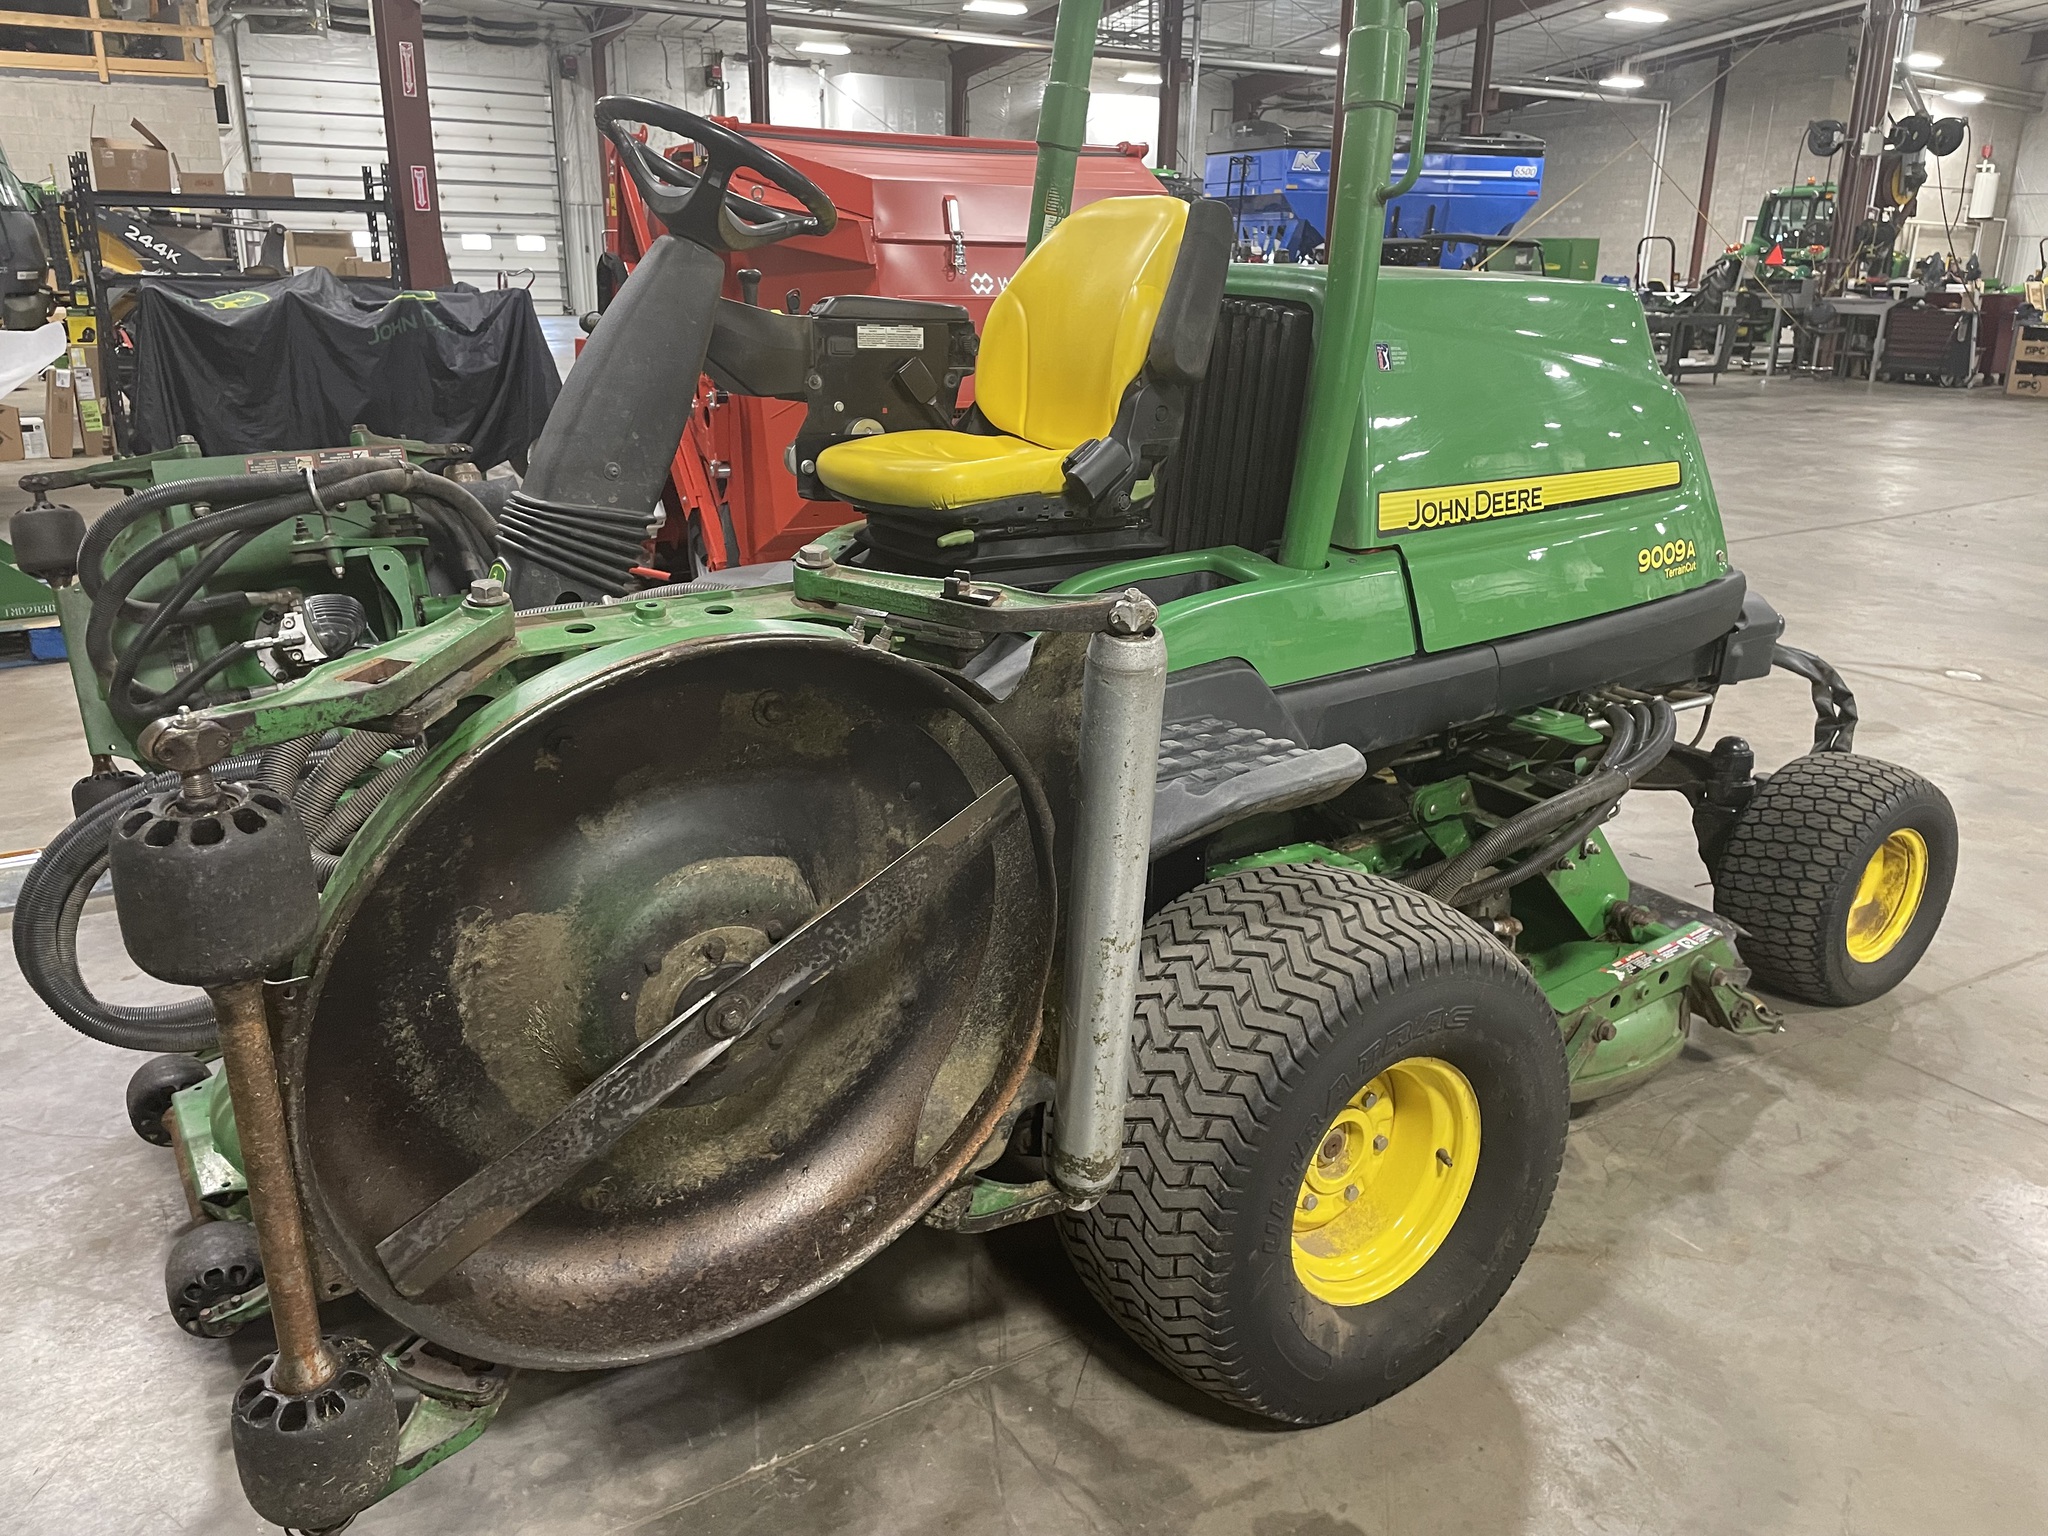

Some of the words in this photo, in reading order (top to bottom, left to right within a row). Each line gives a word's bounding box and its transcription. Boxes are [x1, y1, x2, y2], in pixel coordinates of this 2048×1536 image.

[124, 224, 181, 265] 244K
[367, 313, 419, 346] JOHN
[1407, 497, 1470, 528] JOHN
[1475, 486, 1543, 517] DEERE
[1638, 538, 1697, 573] 9009A
[1664, 561, 1697, 579] TerrainCut
